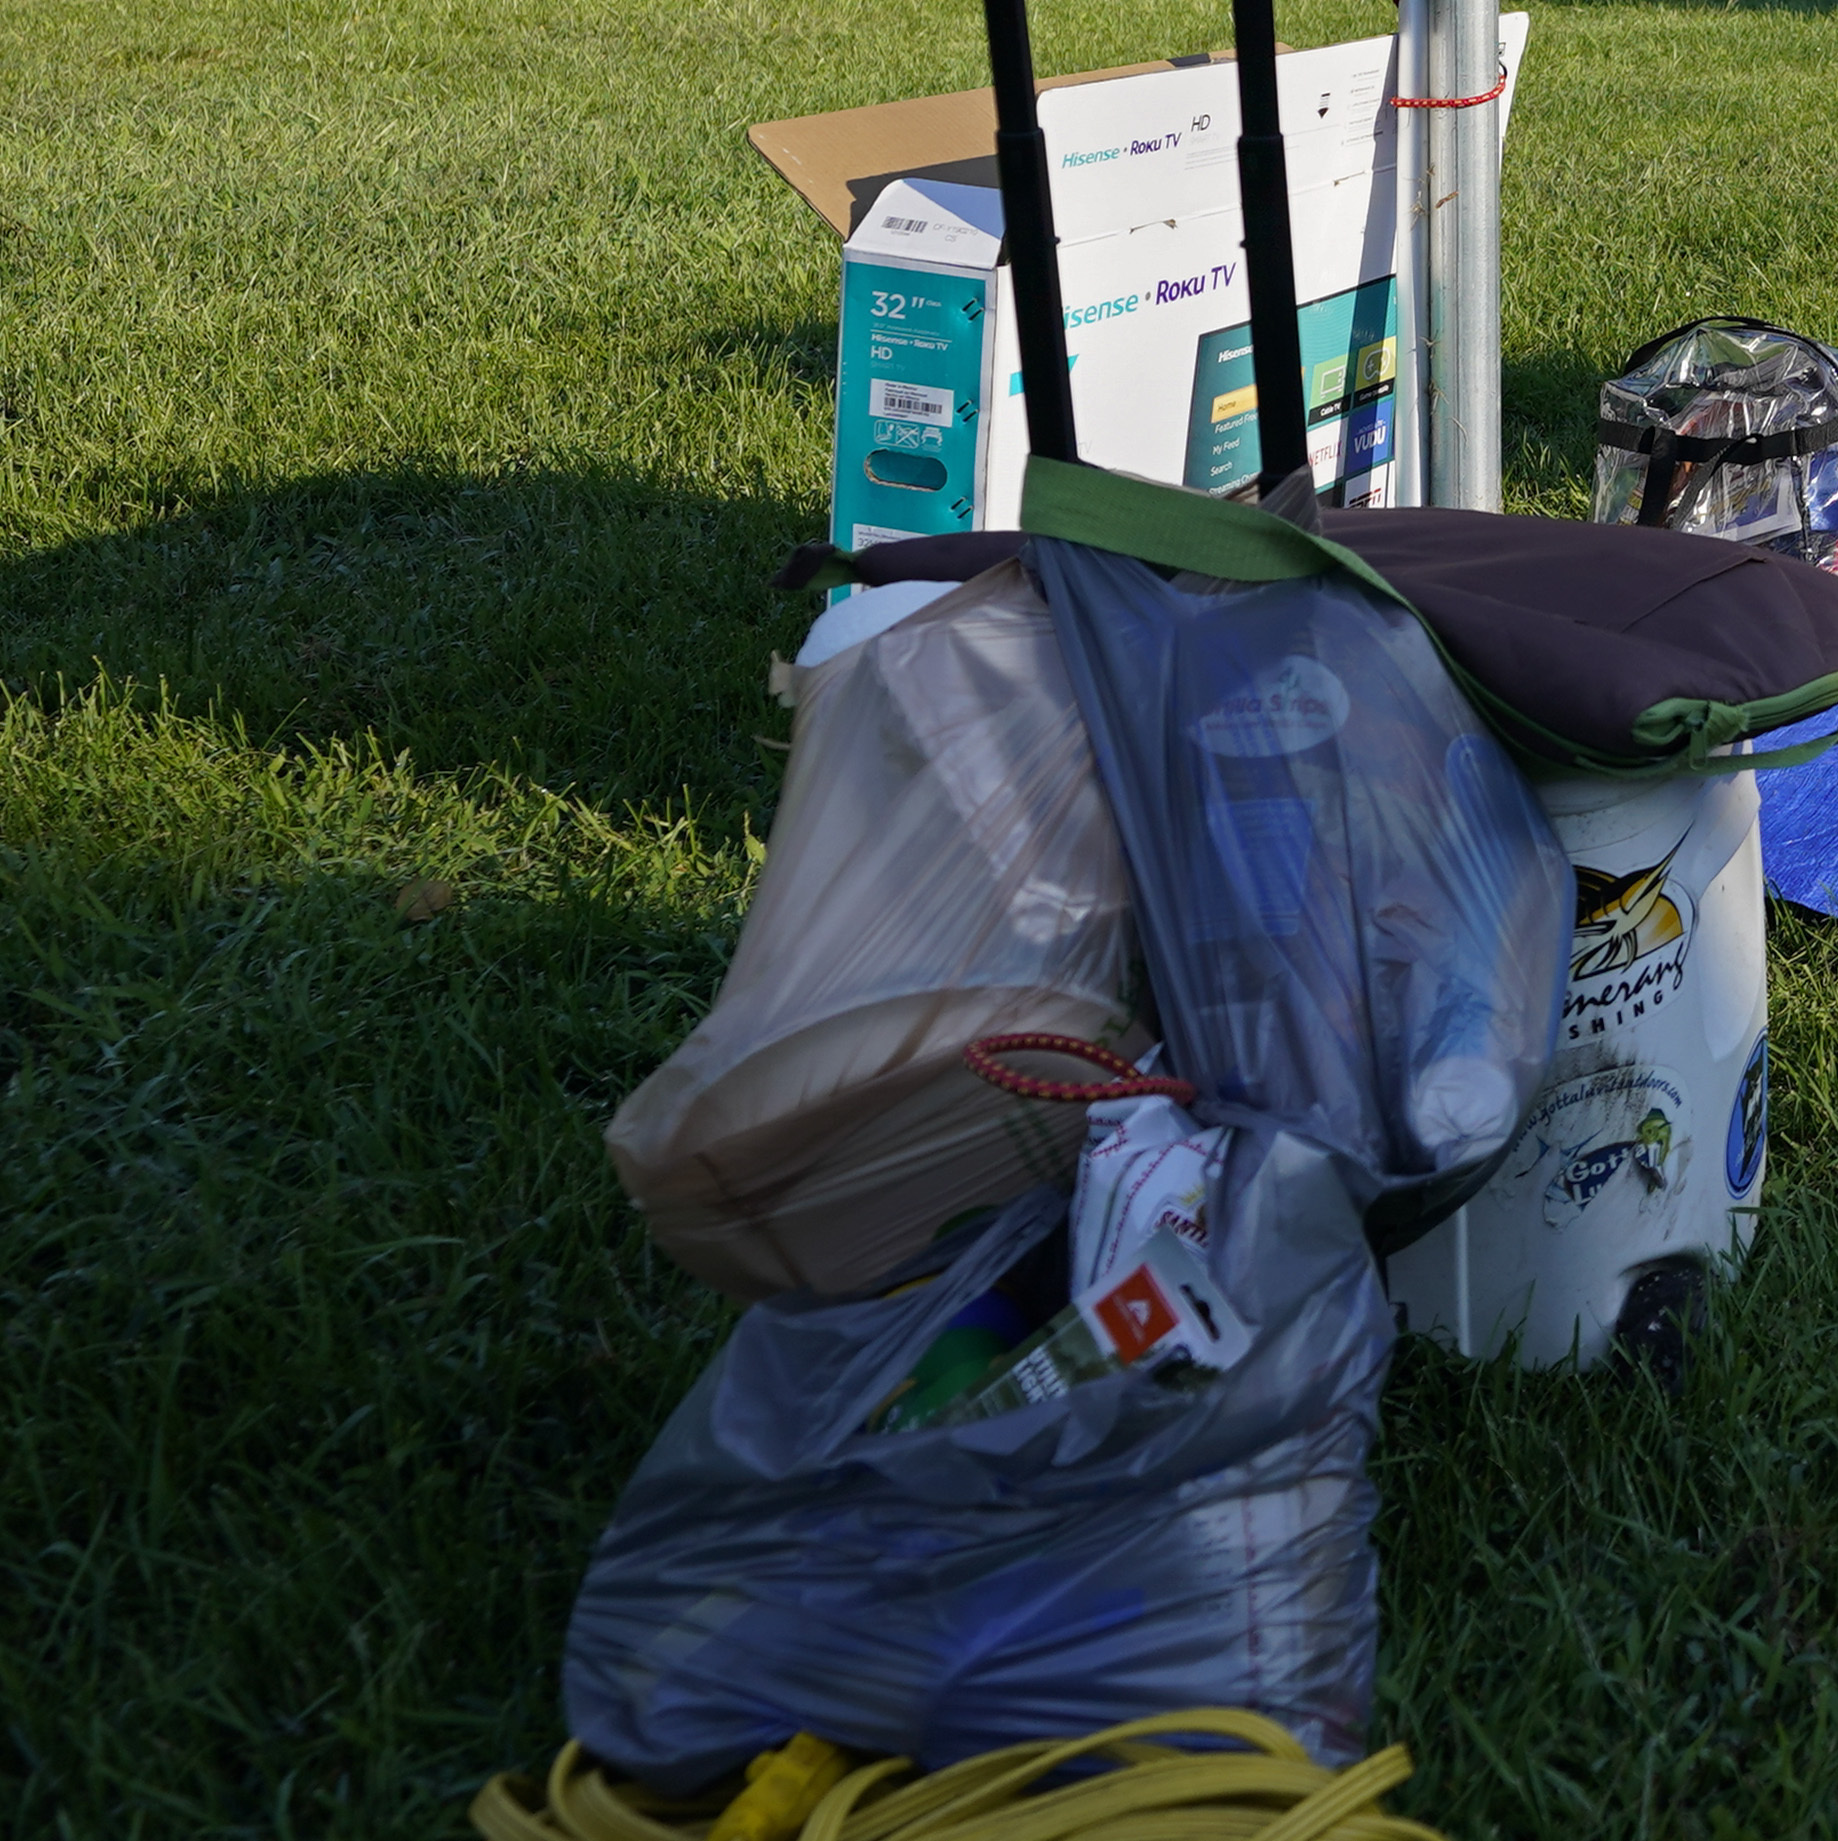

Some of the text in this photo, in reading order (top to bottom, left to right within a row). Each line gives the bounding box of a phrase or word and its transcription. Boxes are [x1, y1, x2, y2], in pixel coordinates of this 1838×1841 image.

[1191, 114, 1211, 133] HD
[1061, 147, 1120, 169] Hisense
[1130, 138, 1162, 156] Roku
[1165, 132, 1182, 149] TV
[1064, 262, 1237, 330] isense Roku TV
[870, 345, 893, 361] HD
[871, 333, 908, 346] Hisense
[936, 342, 949, 352] TV
[1218, 344, 1254, 363] Hisense
[1217, 400, 1237, 413] Home
[1214, 416, 1244, 435] Featured
[1212, 437, 1241, 456] My Feed
[1354, 425, 1386, 453] VUDU
[1308, 442, 1344, 467] NETFLIX
[1210, 461, 1233, 477] Search
[1561, 941, 1685, 1019] merang
[1568, 989, 1663, 1040] SHING
[1572, 1172, 1602, 1205] Lu
[1154, 1211, 1210, 1249] SANTI
